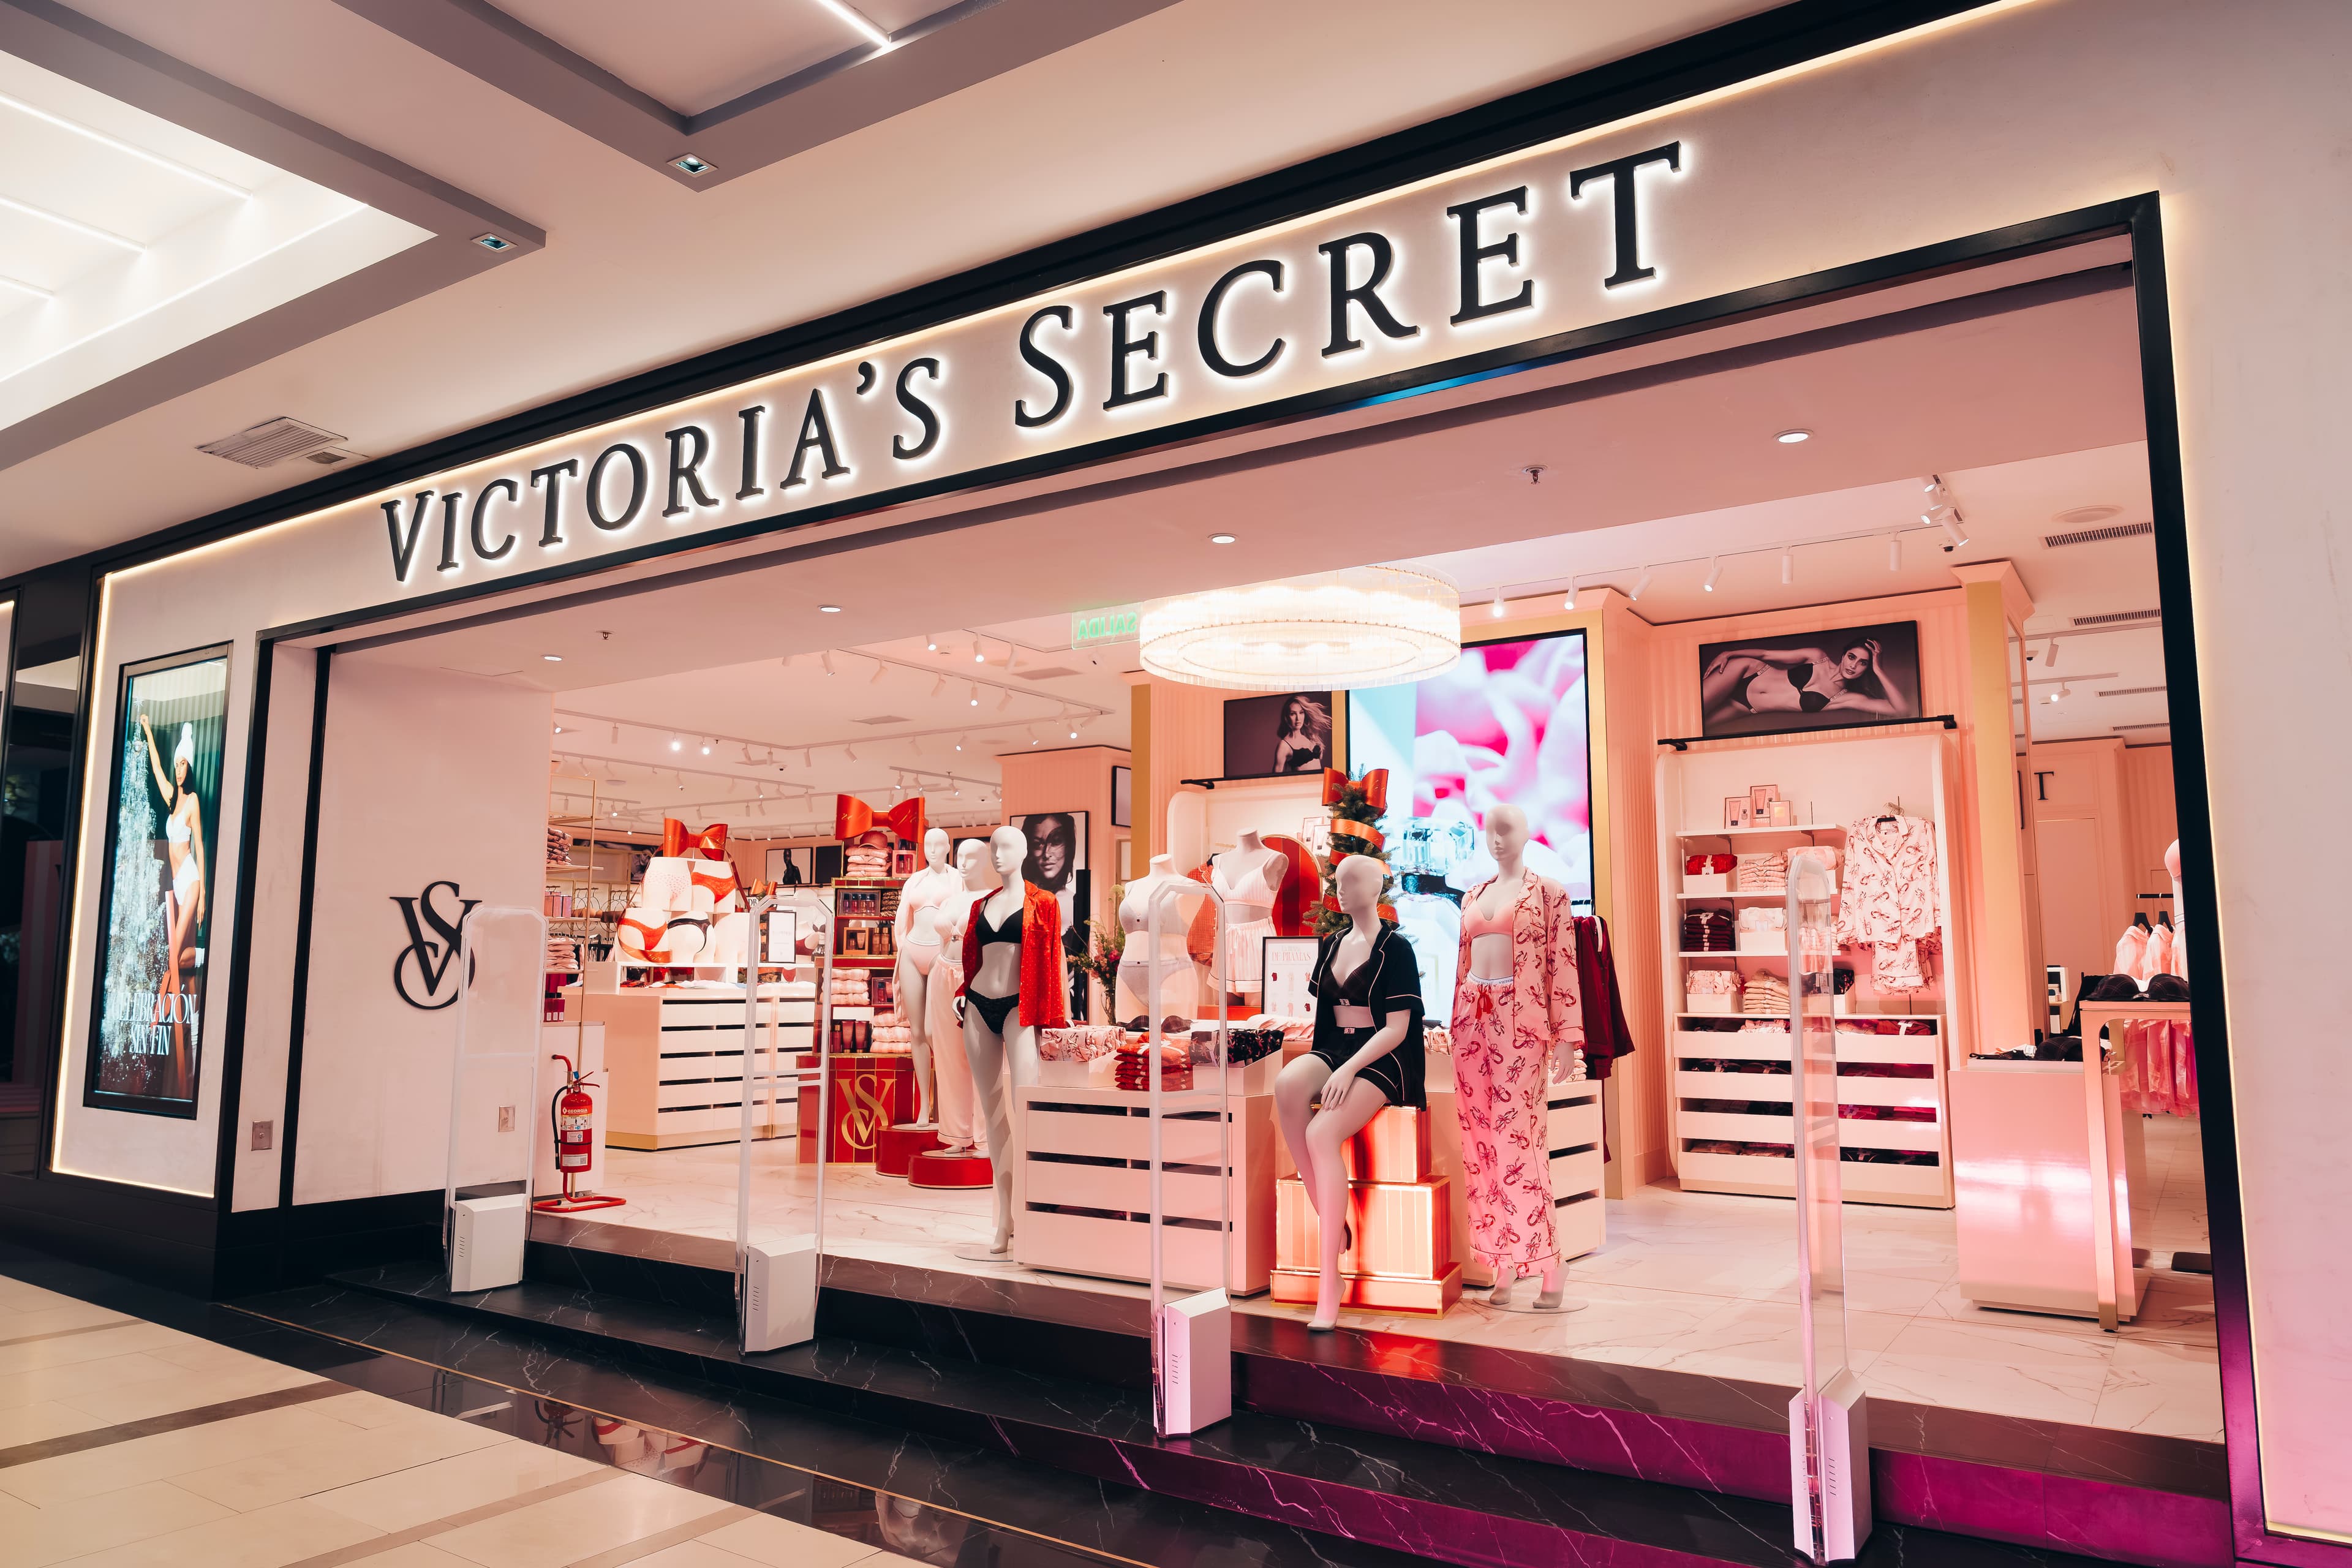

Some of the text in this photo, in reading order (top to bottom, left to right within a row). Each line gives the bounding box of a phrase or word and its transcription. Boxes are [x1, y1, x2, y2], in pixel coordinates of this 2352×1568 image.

[380, 141, 1683, 582] VICTORIA'S SECRET
[129, 1024, 172, 1056] SIN FIN
